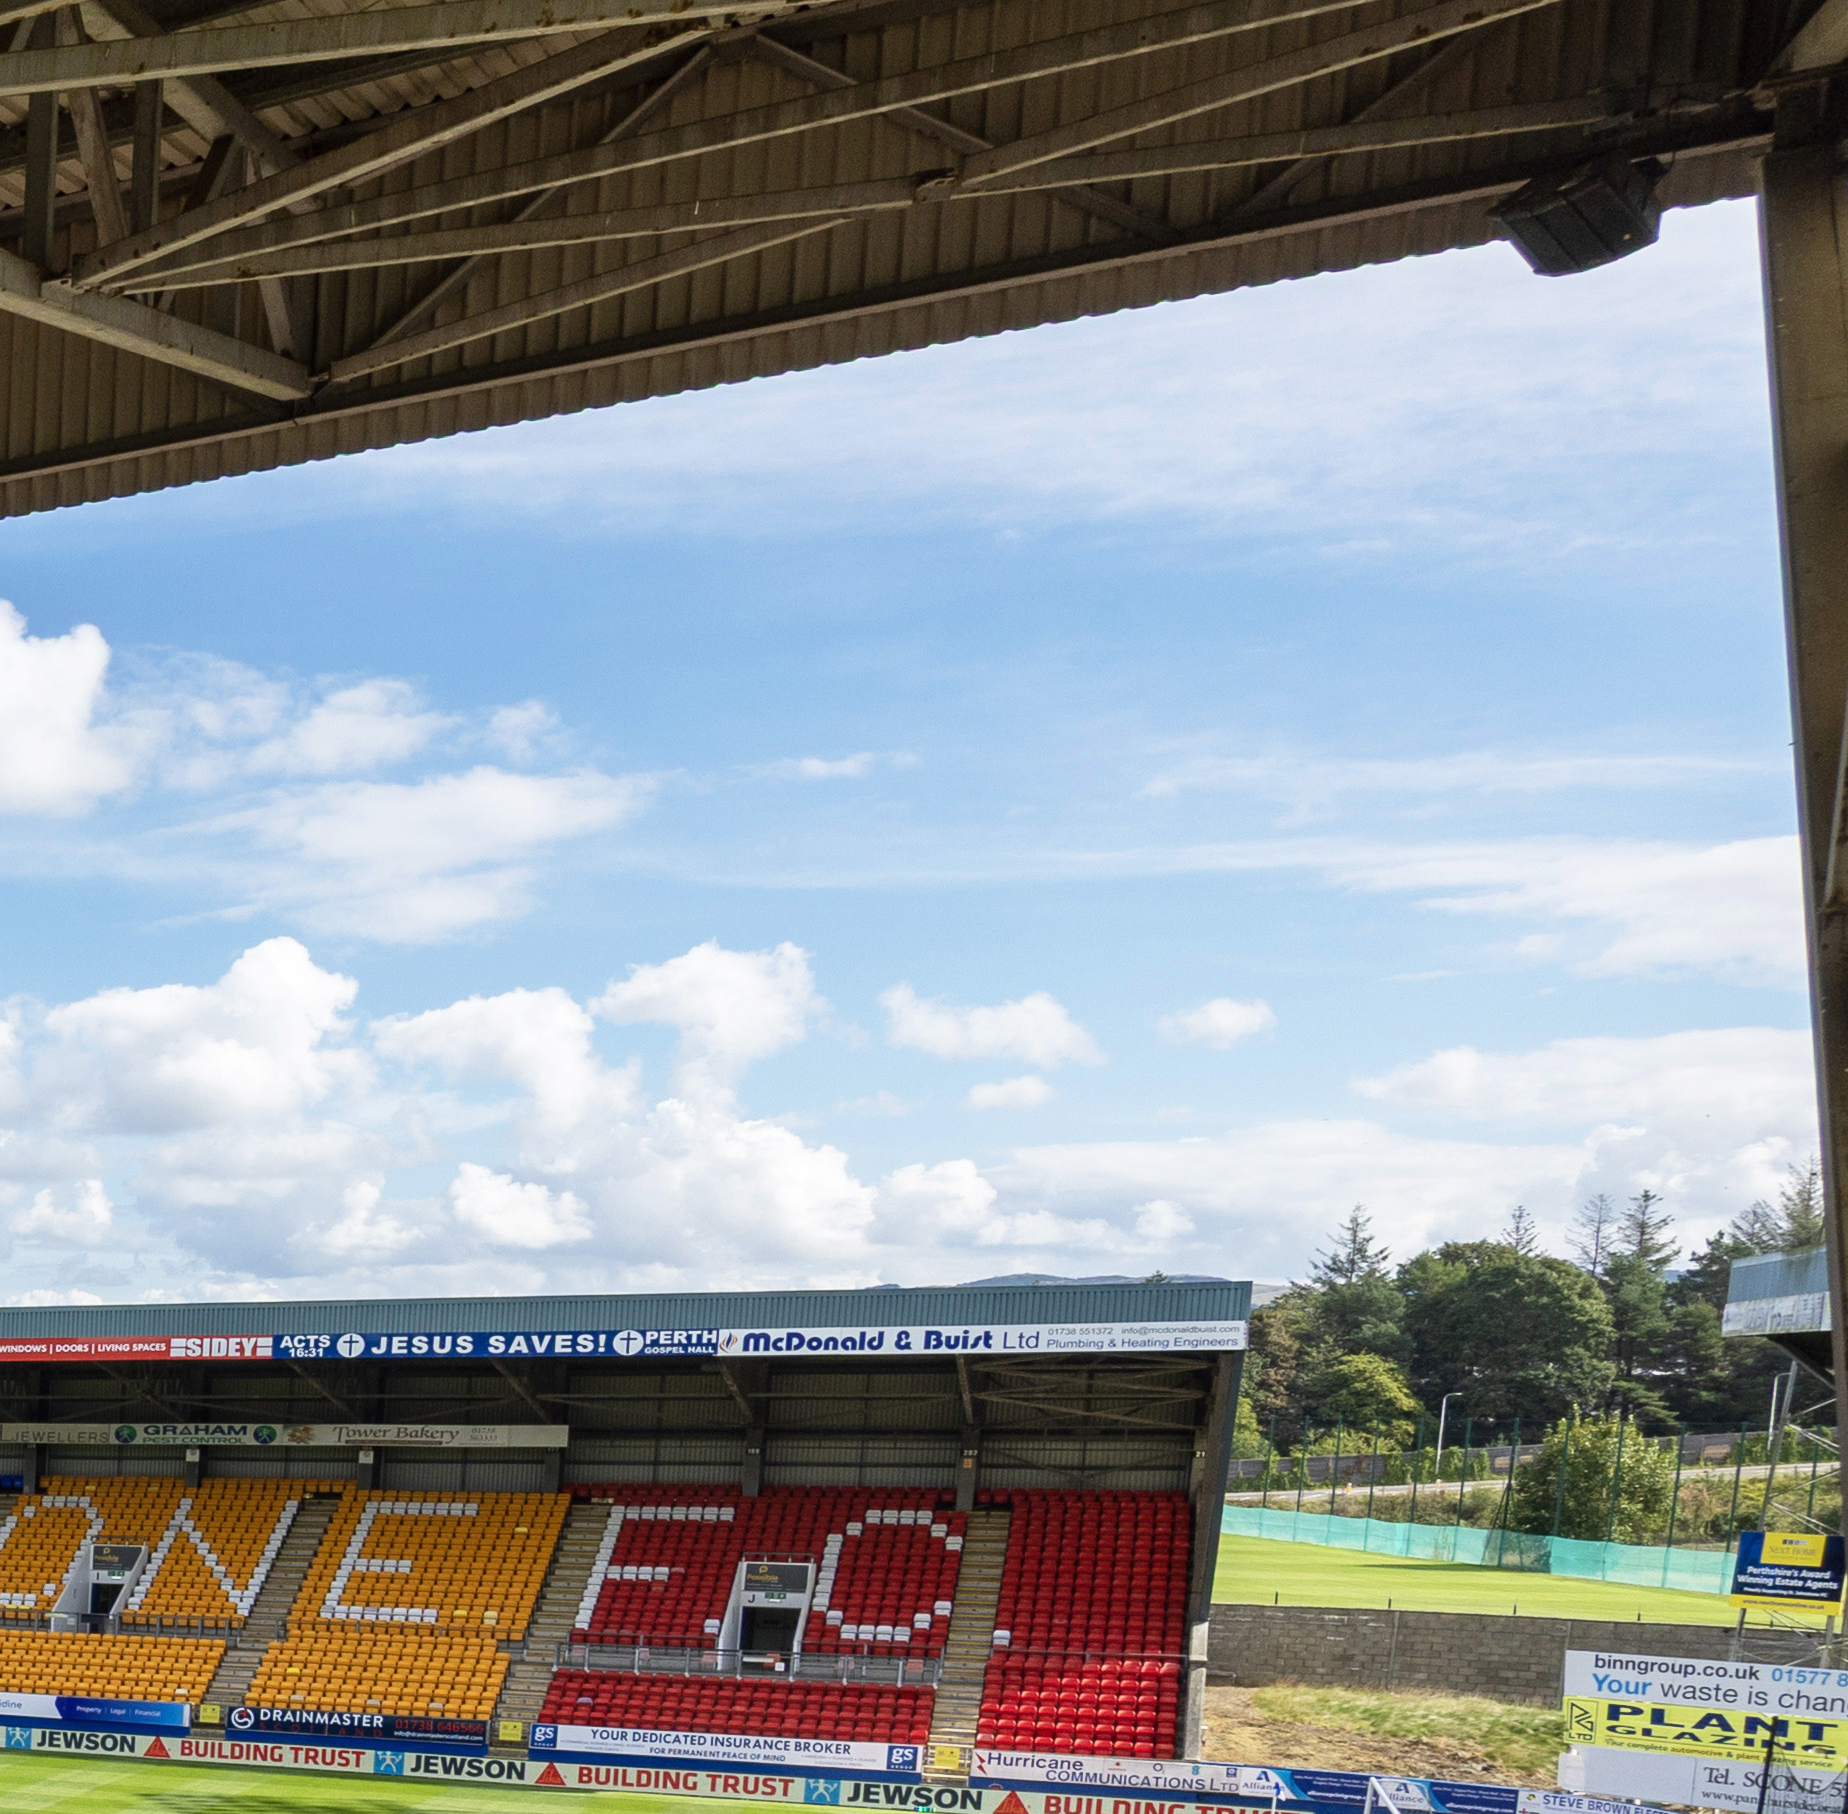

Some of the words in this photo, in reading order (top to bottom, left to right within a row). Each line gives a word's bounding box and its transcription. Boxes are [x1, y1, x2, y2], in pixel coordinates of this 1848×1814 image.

[280, 1335, 331, 1348] ACTS
[371, 1336, 474, 1355] JESUS
[488, 1334, 606, 1353] SAVES!
[645, 1331, 718, 1344] PERTH
[743, 1331, 884, 1351] McDonald
[894, 1331, 912, 1350] &
[924, 1330, 992, 1350] Buist
[1003, 1331, 1039, 1349] Ltd
[1047, 1338, 1103, 1350] Plumbing
[1108, 1338, 1117, 1348] &
[1121, 1338, 1170, 1349] Heating
[1174, 1336, 1238, 1349] Engineers
[289, 1347, 324, 1358] 16:31
[333, 1425, 392, 1442] Tower
[398, 1426, 459, 1443] Bakery
[1737, 1574, 1773, 1587] Winning
[1775, 1577, 1803, 1588] Estate
[1804, 1579, 1838, 1591] Agents
[1746, 1565, 1798, 1578] Perthshire's
[1800, 1569, 1830, 1580] Award
[1594, 1654, 1760, 1682] binngroup.co.uk
[1771, 1668, 1830, 1686] 01577
[1593, 1673, 1652, 1696] Your
[1660, 1682, 1738, 1704] waste
[1747, 1686, 1768, 1706] is
[1778, 1686, 1848, 1715] chan
[260, 1708, 383, 1728] DRAINMASTER
[1607, 1704, 1838, 1741] PLANT
[591, 1729, 628, 1743] YOUR
[632, 1731, 707, 1747] DEDICATED
[710, 1735, 791, 1751] INSURANCE
[794, 1740, 851, 1755] BROKER
[1606, 1725, 1836, 1756] GLAZING
[180, 1739, 283, 1763] BUILDING
[289, 1746, 365, 1768] TRUST
[649, 1746, 666, 1755] FOR
[668, 1748, 721, 1759] PERMANENT
[723, 1750, 748, 1760] PEACE
[750, 1753, 761, 1761] OF
[763, 1753, 786, 1762] MIND
[988, 1752, 1084, 1770] Hurricane
[410, 1754, 525, 1781] JEWSON
[578, 1766, 698, 1791] BUILDING
[705, 1774, 795, 1797] TRUST
[1046, 1769, 1205, 1791] COMMUNICATIONS
[1209, 1778, 1239, 1792] LTD
[847, 1782, 982, 1810] JEWSON
[1543, 1794, 1583, 1809] STEVE
[1587, 1800, 1629, 1814] BROWN
